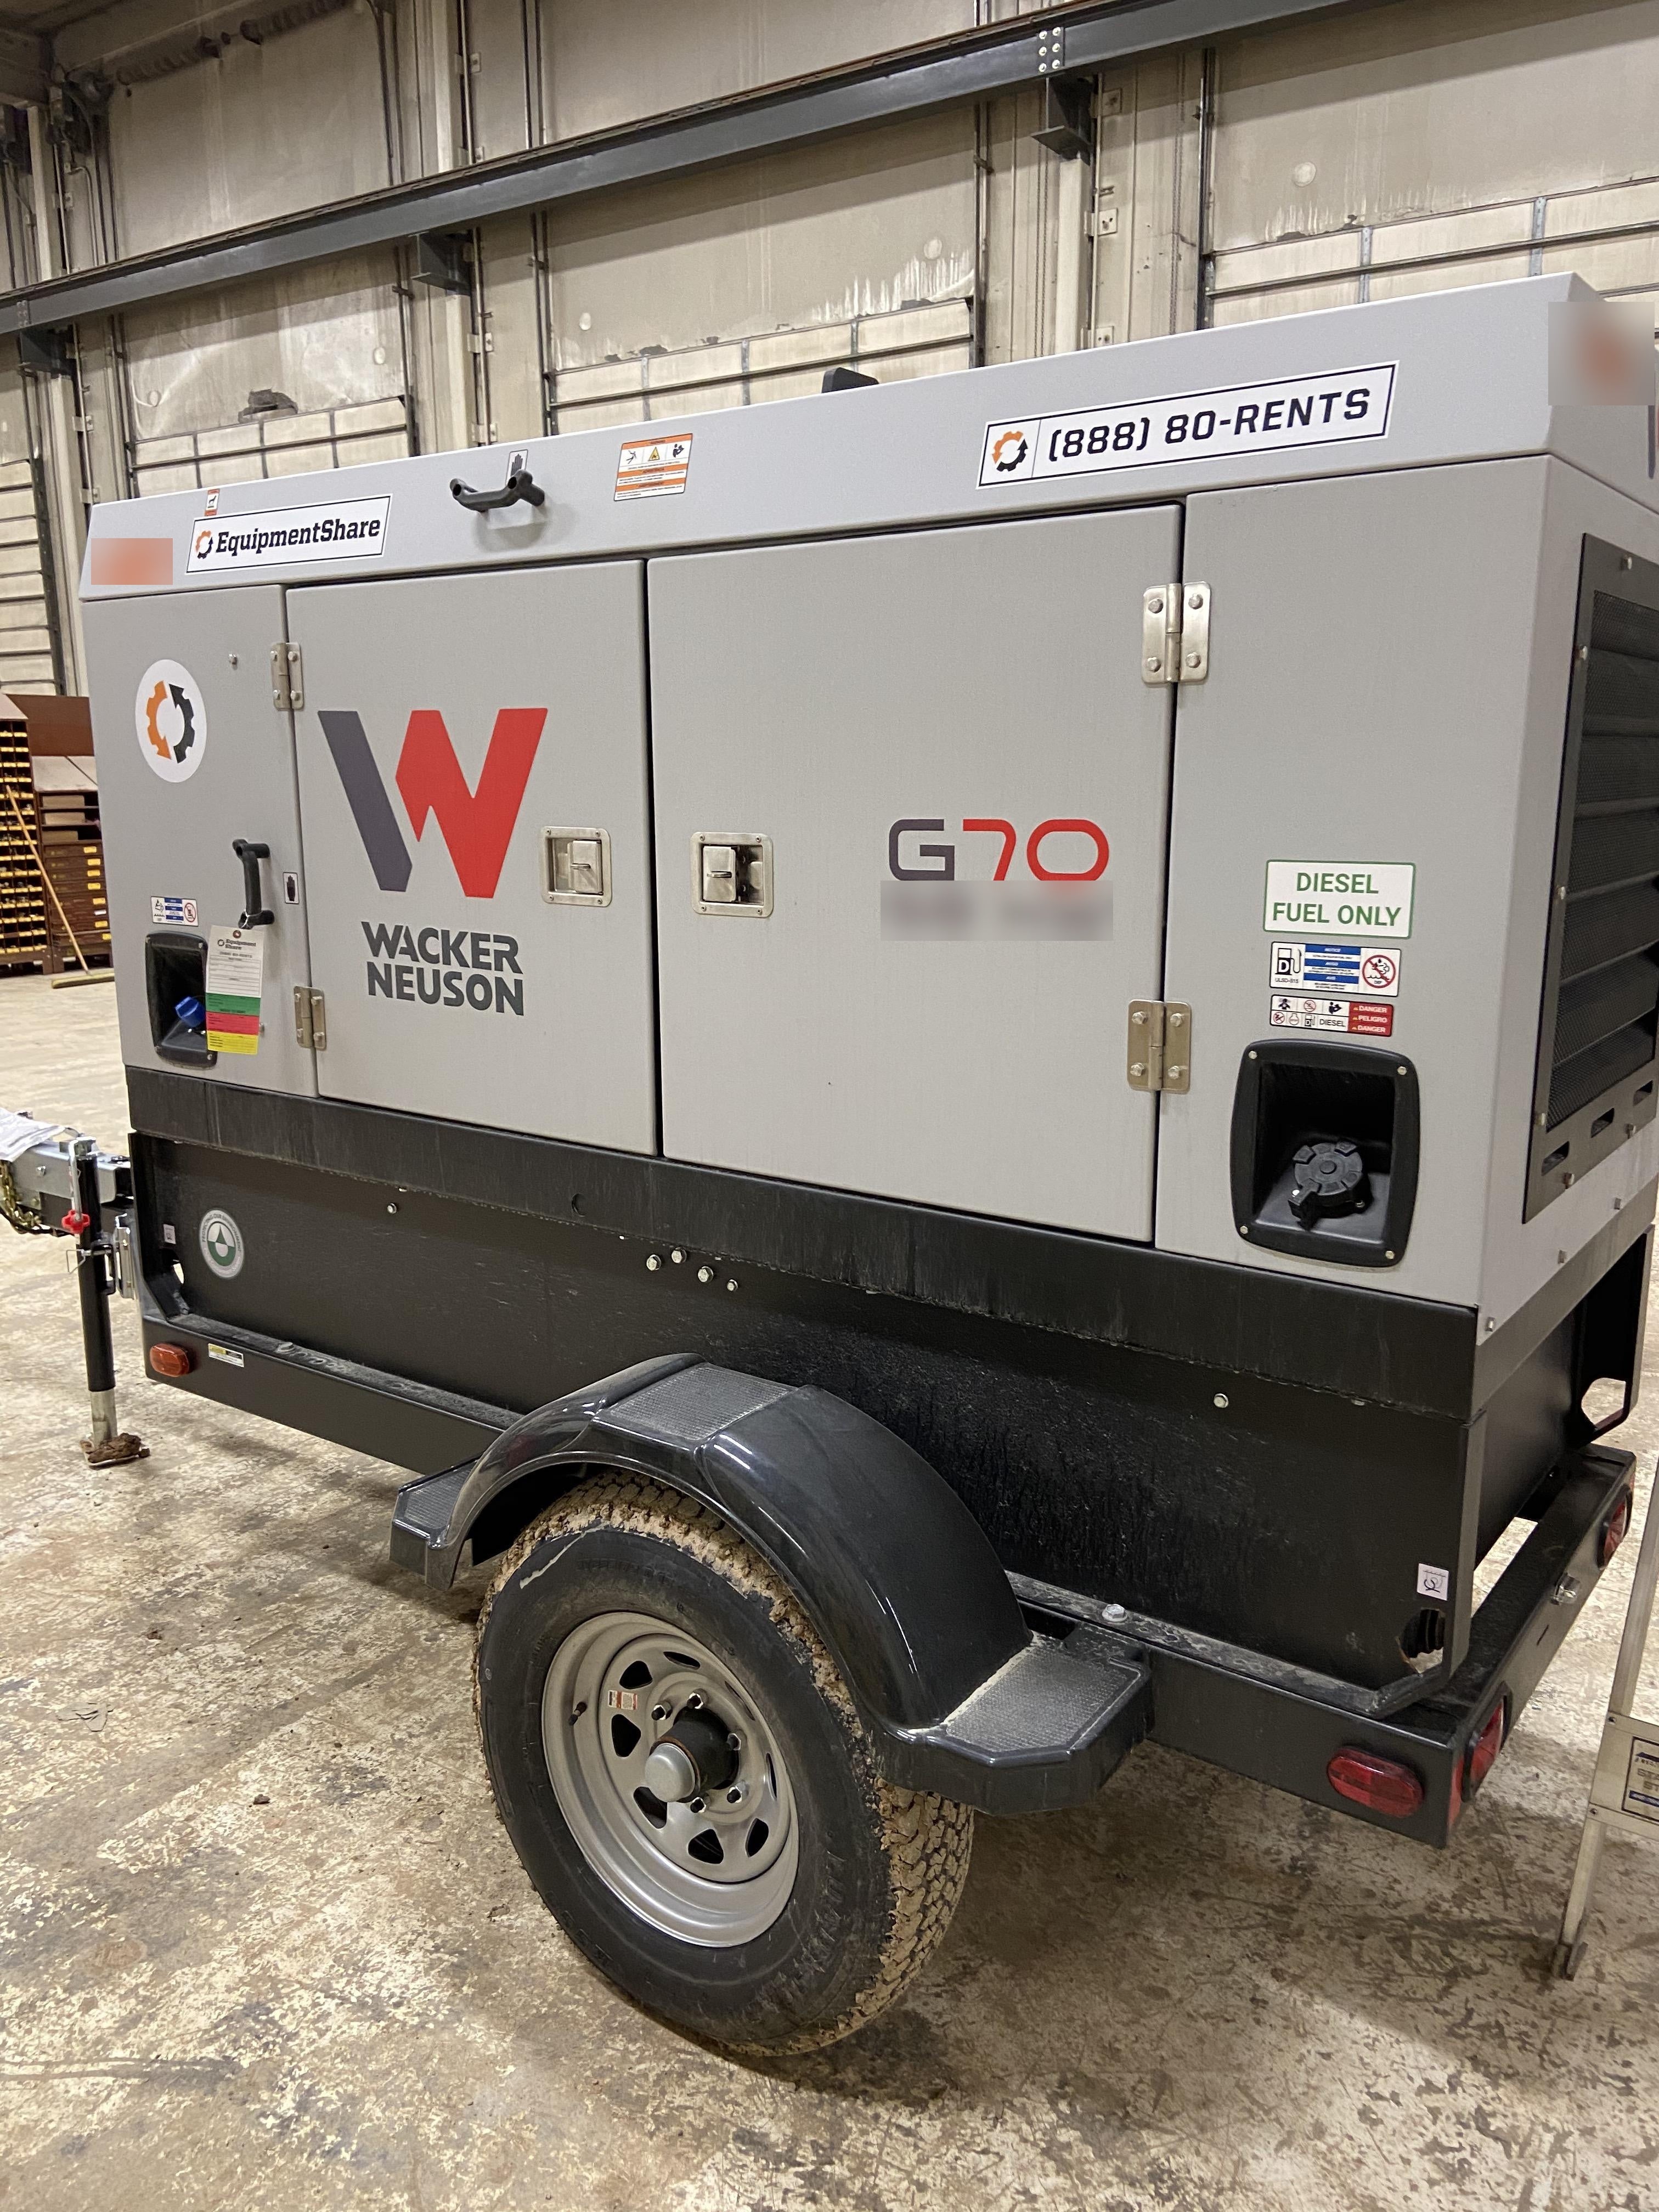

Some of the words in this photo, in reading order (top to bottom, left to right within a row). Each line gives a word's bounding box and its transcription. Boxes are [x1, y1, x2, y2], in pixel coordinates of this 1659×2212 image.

[1049, 417, 1150, 462] (888)
[1164, 388, 1372, 445] 80-RENTS
[216, 517, 381, 556] EquipmentShare
[889, 819, 1110, 881] G70
[1296, 872, 1379, 894] DIESEL
[1273, 902, 1330, 923] FUEL
[1338, 905, 1402, 927] ONLY
[361, 921, 524, 974] WACKER
[366, 961, 524, 1016] NEUSON
[1319, 1019, 1346, 1027] DIESEL
[1358, 1005, 1387, 1013] DANGER
[1358, 1015, 1387, 1023] PELIGRO
